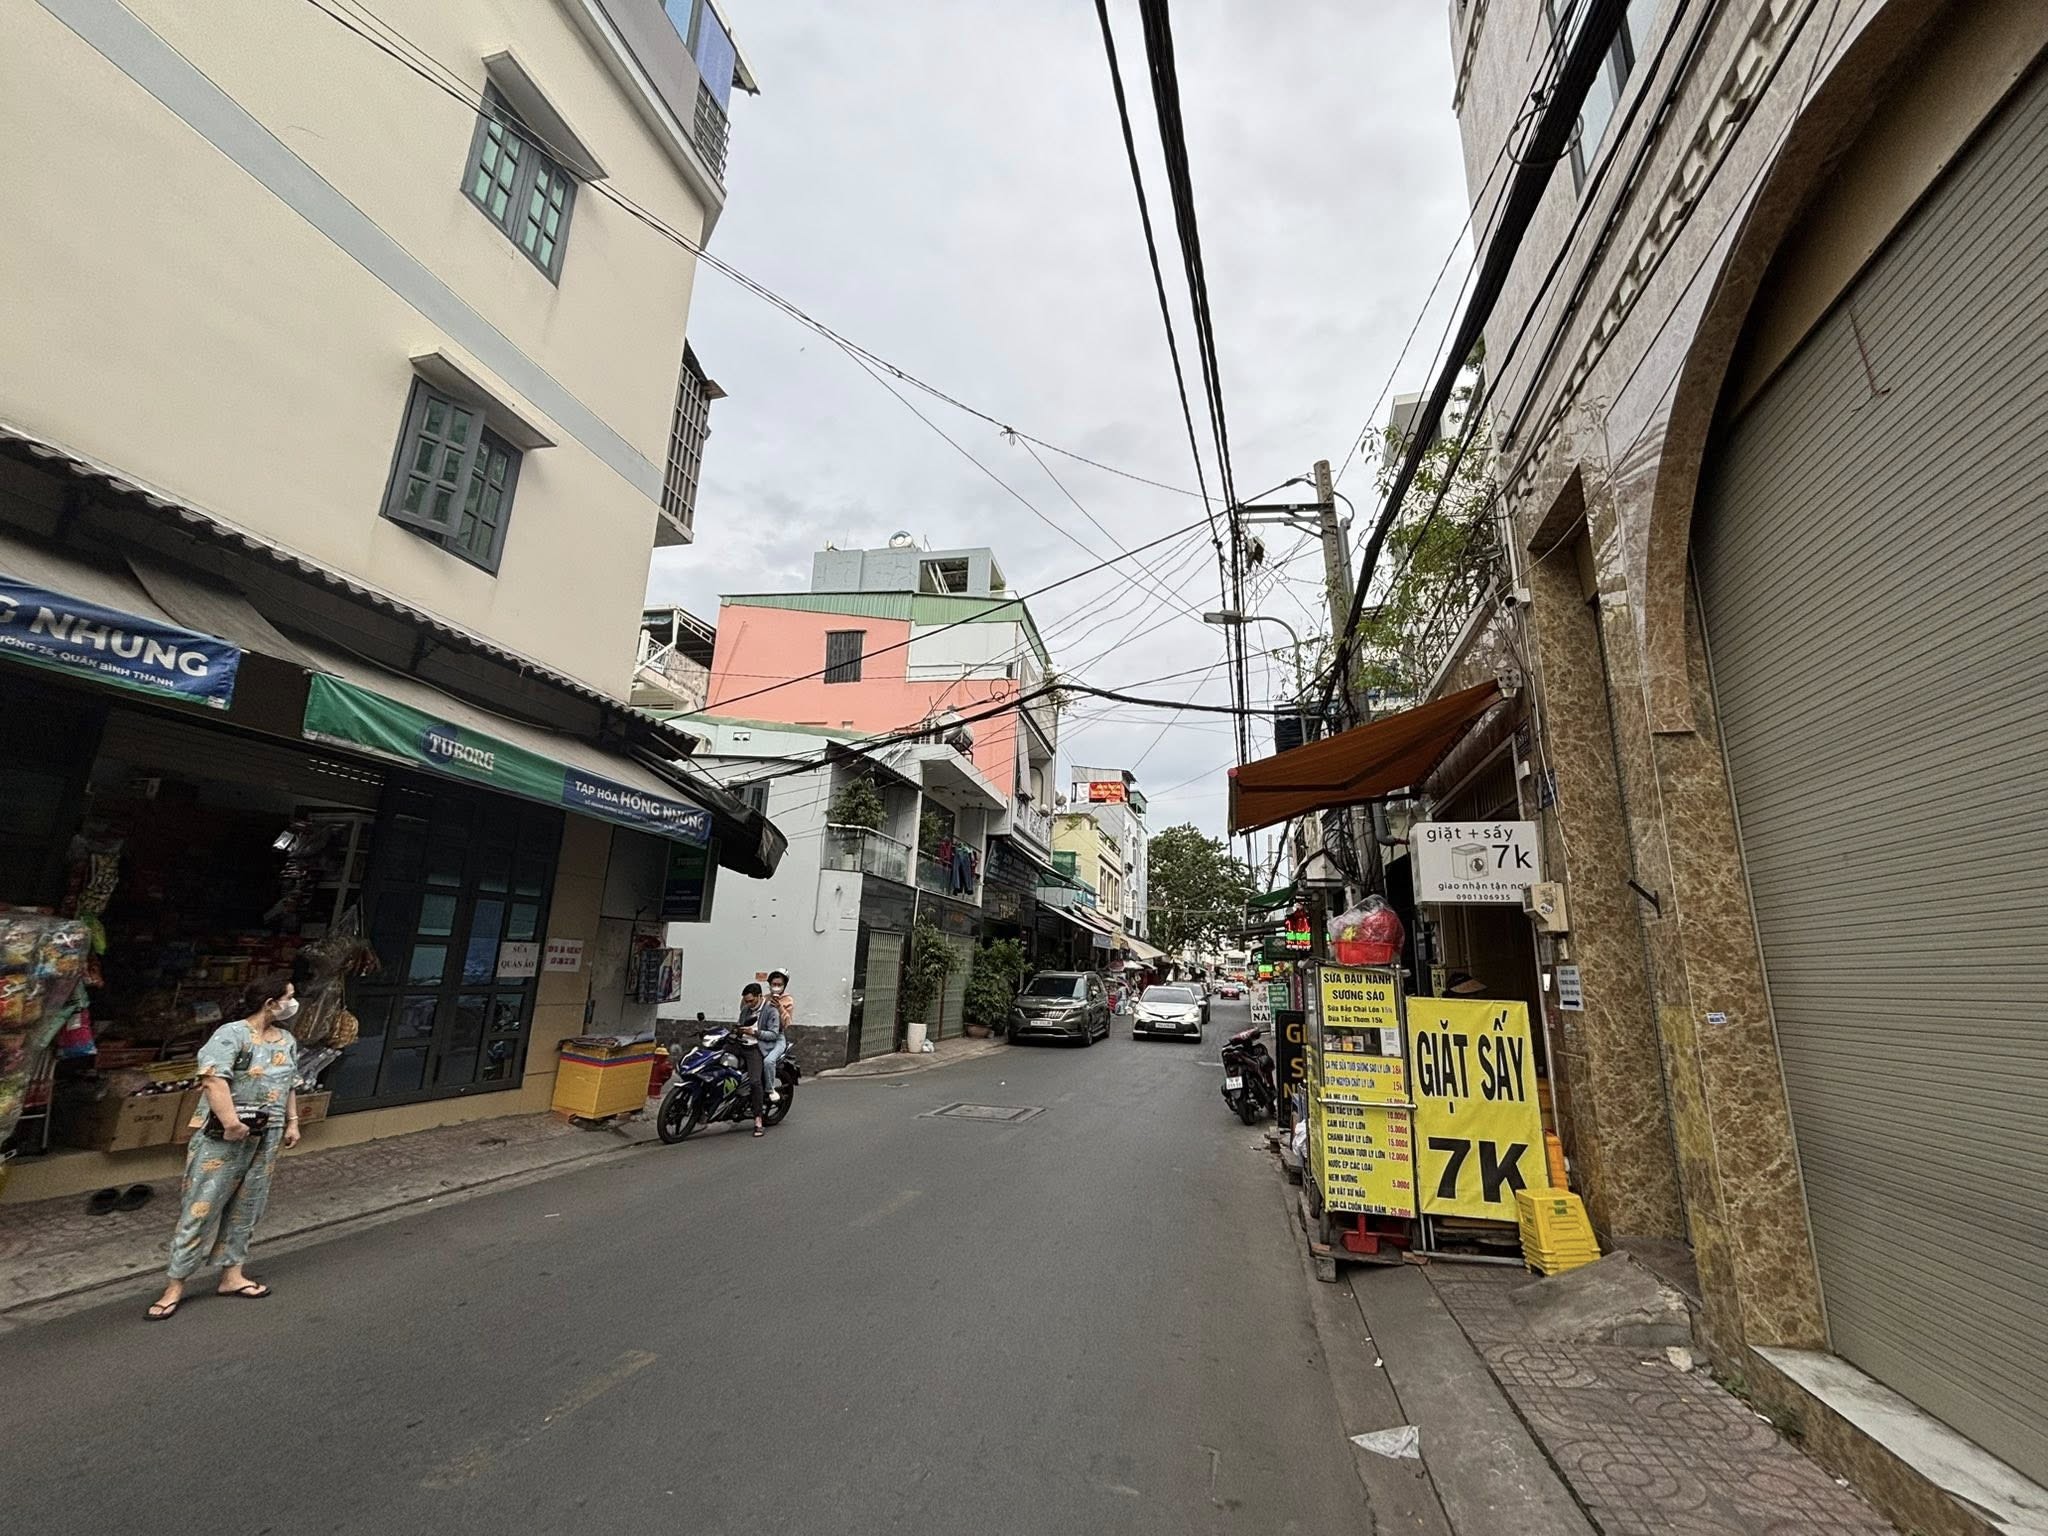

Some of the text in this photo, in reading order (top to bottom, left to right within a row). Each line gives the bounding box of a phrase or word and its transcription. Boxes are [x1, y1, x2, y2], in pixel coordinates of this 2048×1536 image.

[30, 605, 210, 678] NHUNG
[429, 732, 495, 770] TUBORG
[575, 780, 596, 796] TẠP
[597, 788, 619, 803] HÓA
[620, 791, 661, 817] HỒNG
[1426, 826, 1462, 843] giặt
[1483, 825, 1514, 843] sấy
[1438, 882, 1460, 892] giao
[1462, 881, 1488, 892] nhận
[1490, 881, 1509, 892] tận
[1332, 990, 1364, 1001] SƯƠNG
[1416, 1019, 1469, 1114] GIẶT
[1477, 1010, 1526, 1102] SẤY
